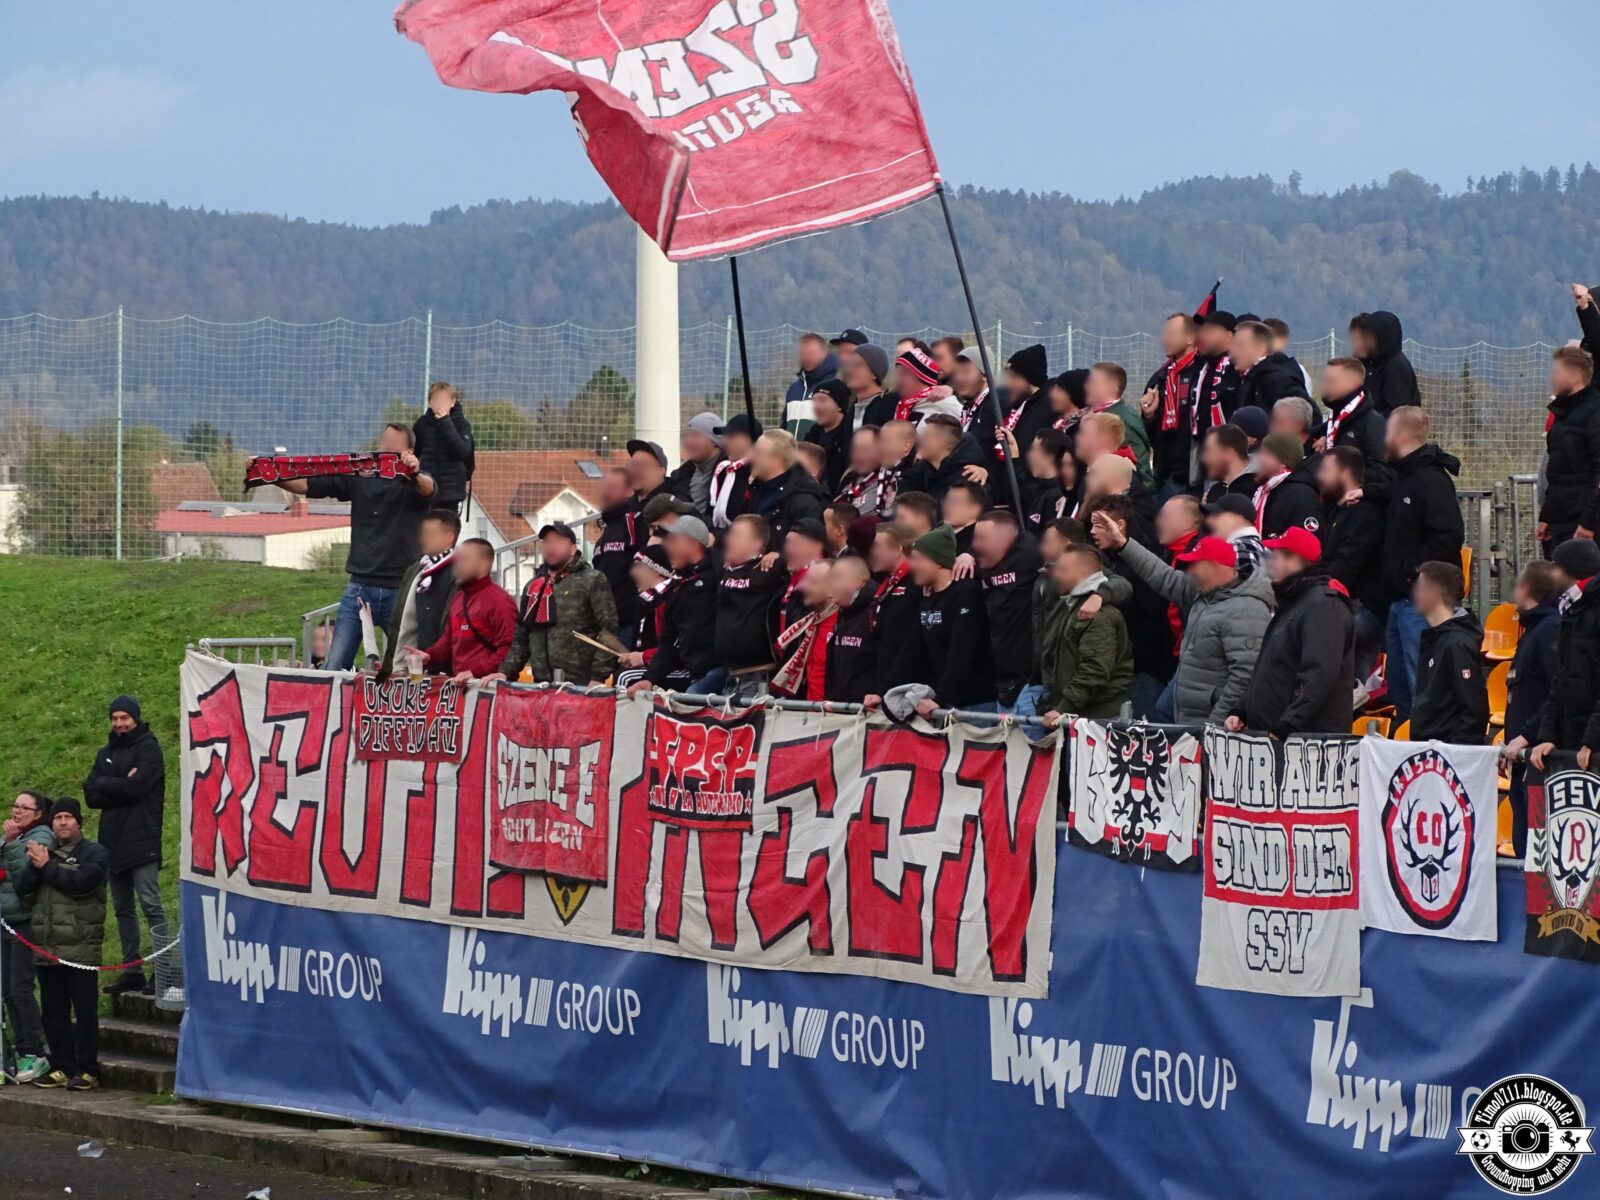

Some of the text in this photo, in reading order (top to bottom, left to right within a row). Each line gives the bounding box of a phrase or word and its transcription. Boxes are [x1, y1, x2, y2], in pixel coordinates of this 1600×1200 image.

[360, 714, 460, 754] DIFFIDATI
[497, 731, 601, 830] SZENE E
[1206, 733, 1360, 813] WIR ALLE
[1211, 815, 1354, 897] SIND DER
[1568, 821, 1586, 864] R
[1246, 907, 1312, 974] SSV
[304, 948, 382, 1002] GROUP
[556, 980, 641, 1036] GROUP
[831, 1010, 925, 1070] GROUP
[1131, 1047, 1237, 1111] GROUP
